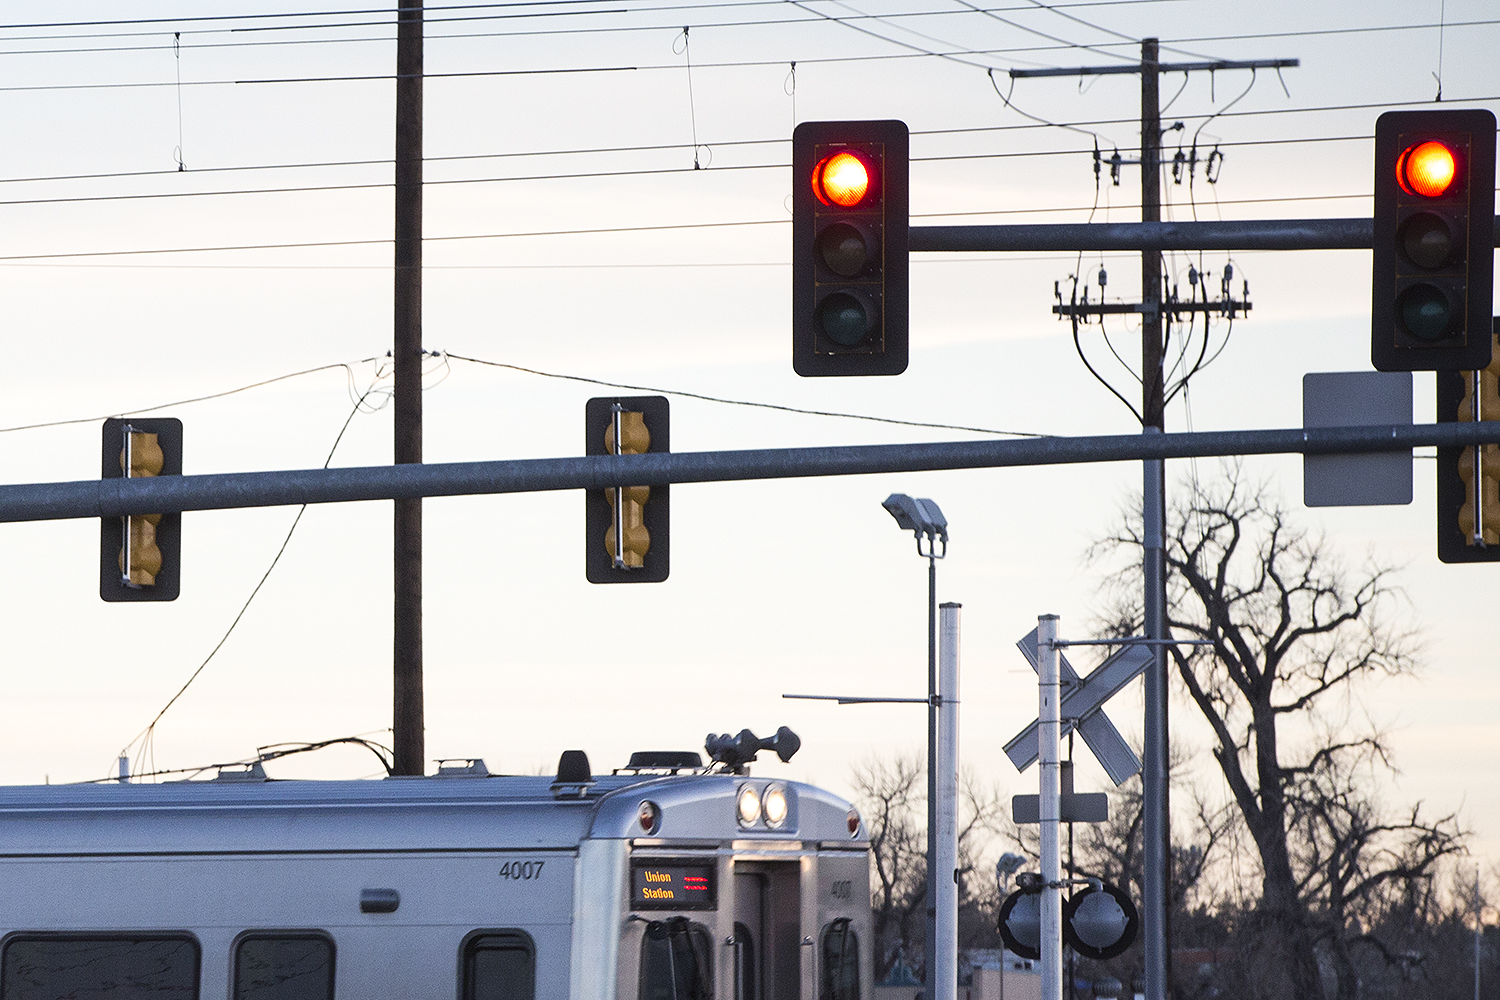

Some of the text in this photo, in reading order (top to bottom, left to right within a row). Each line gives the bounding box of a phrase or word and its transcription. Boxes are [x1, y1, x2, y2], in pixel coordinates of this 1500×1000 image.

[499, 861, 545, 880] 4007
[644, 871, 672, 882] Union
[642, 887, 674, 899] Station
